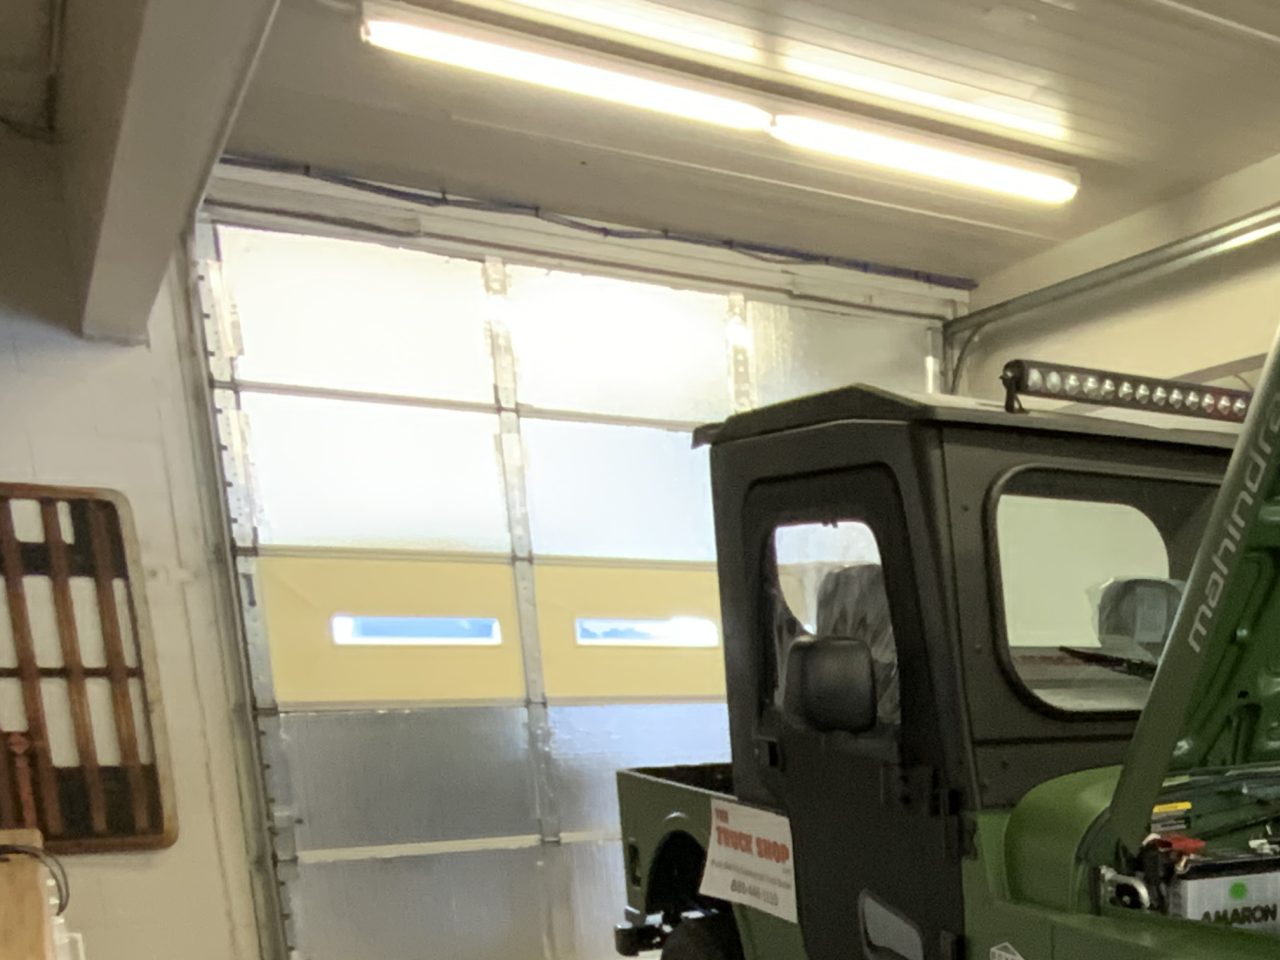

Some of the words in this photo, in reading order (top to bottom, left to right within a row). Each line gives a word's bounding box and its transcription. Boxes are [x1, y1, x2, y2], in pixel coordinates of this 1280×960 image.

[716, 826, 753, 855] TRUCK
[756, 837, 790, 864] SHOP
[1201, 903, 1278, 925] AMARON
